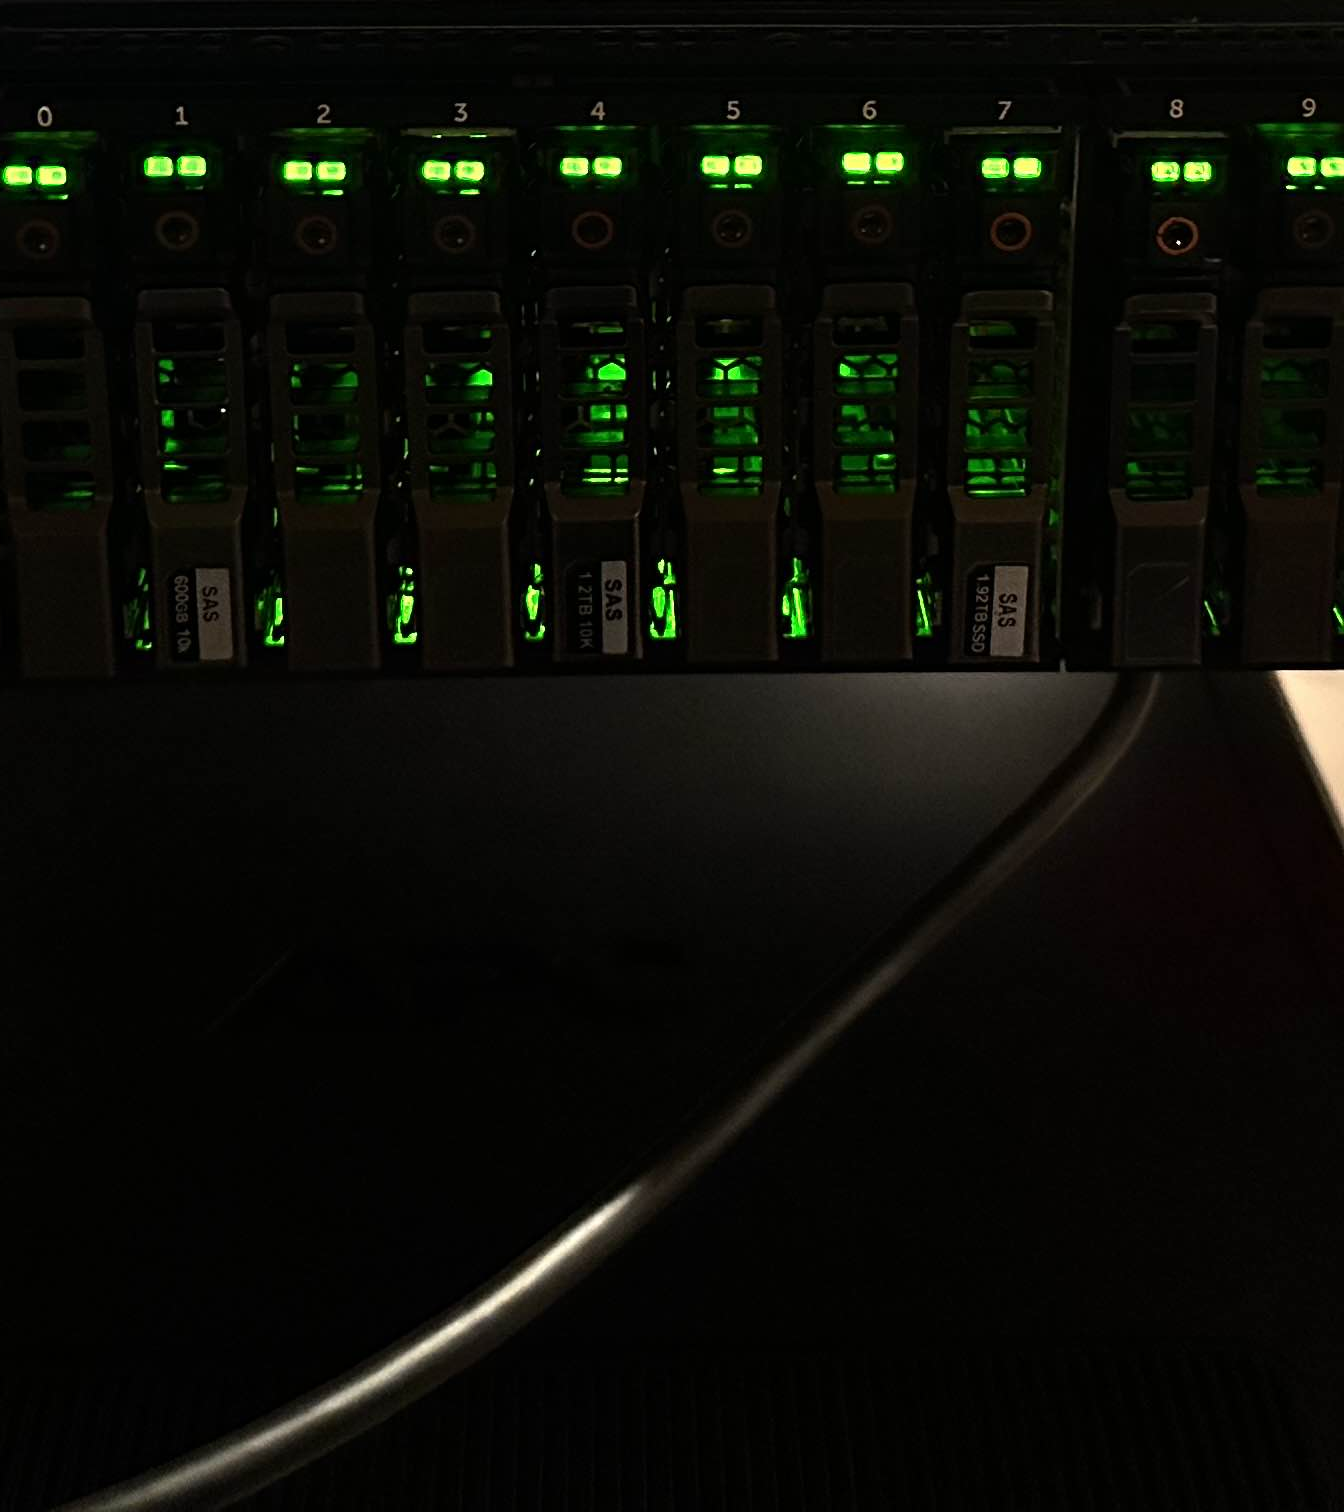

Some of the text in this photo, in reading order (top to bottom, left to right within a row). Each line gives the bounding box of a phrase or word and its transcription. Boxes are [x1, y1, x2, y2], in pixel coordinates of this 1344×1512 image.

[37, 105, 53, 126] 0
[174, 106, 188, 126] 1
[316, 104, 332, 123] 2
[454, 102, 468, 122] 3
[591, 101, 606, 121] 4
[726, 100, 741, 120] 5
[862, 100, 877, 120] 6
[998, 100, 1012, 120] 7
[1169, 98, 1184, 119] 8
[1302, 97, 1317, 118] 9
[173, 574, 190, 624] 600GB
[202, 586, 219, 622] SAS
[604, 579, 623, 621] SAS
[998, 593, 1018, 628] SAS
[970, 624, 987, 653] SSD
